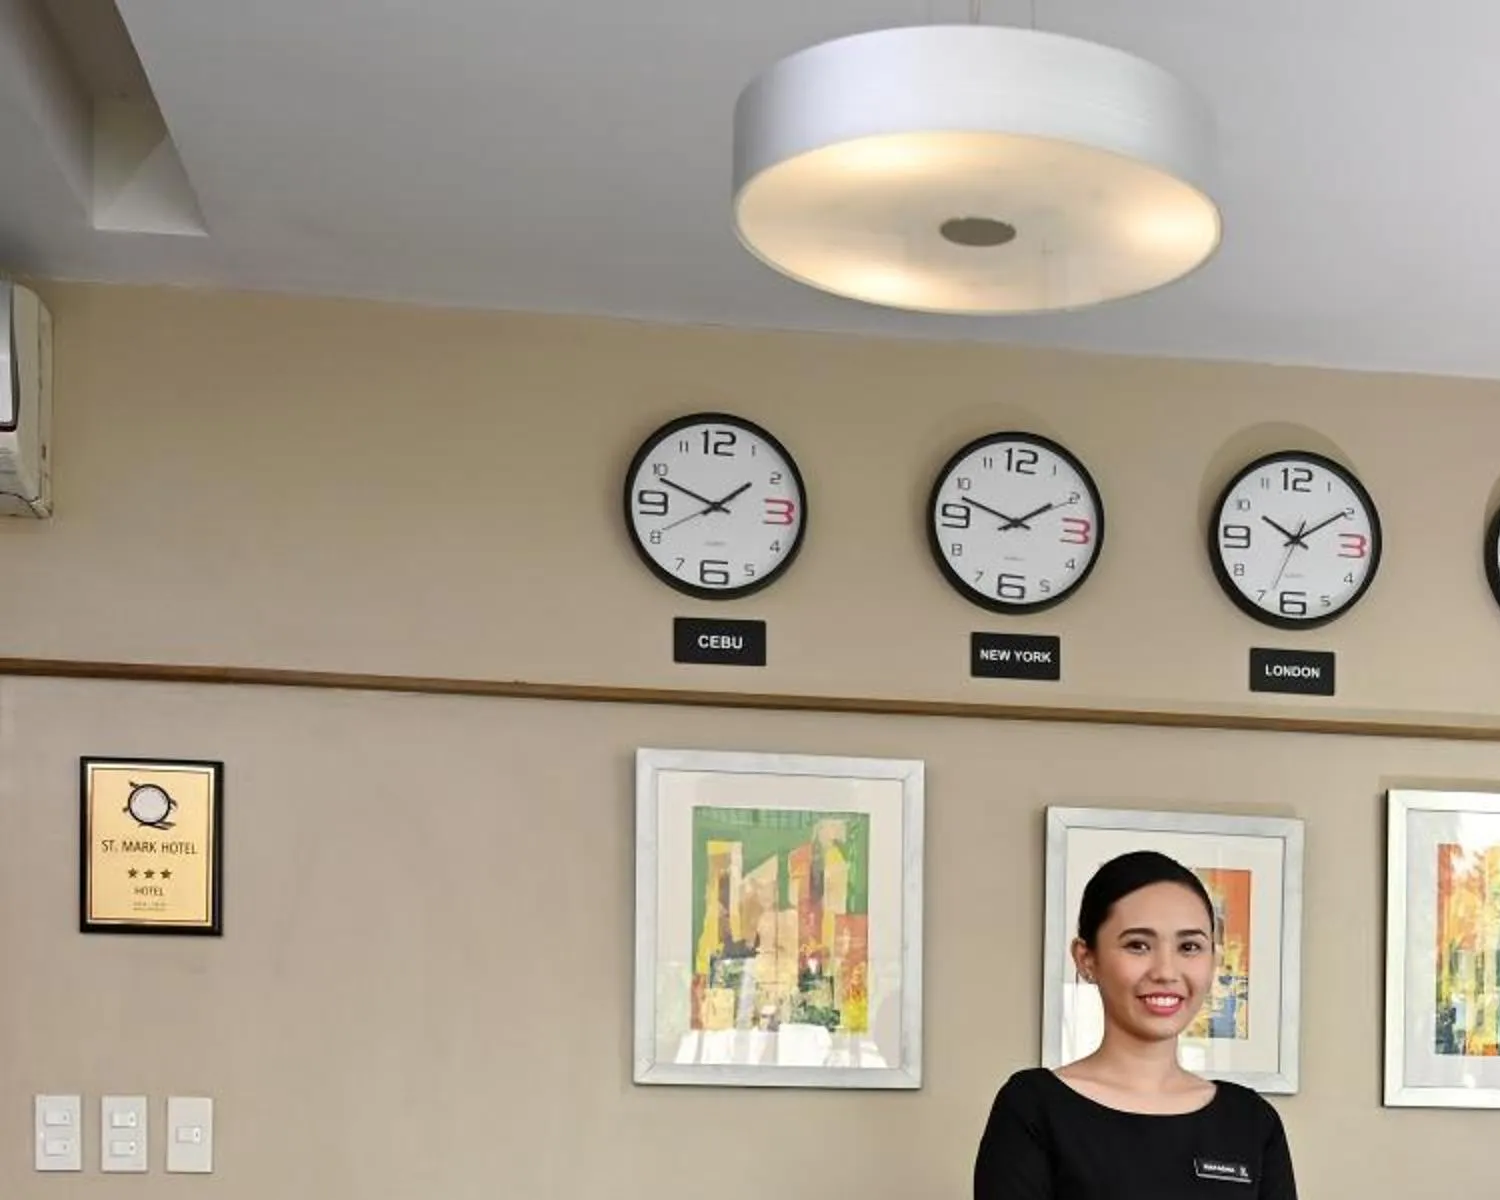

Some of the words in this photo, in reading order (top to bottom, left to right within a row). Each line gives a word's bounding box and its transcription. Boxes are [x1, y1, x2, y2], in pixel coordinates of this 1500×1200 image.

[679, 440, 689, 453] 11
[701, 429, 737, 457] 12
[983, 456, 993, 469] 11
[1004, 447, 1039, 475] 12
[652, 463, 669, 476] 10
[769, 471, 782, 485] 2
[957, 477, 971, 491] 10
[1261, 477, 1270, 490] 11
[1282, 467, 1313, 492] 12
[638, 490, 669, 516] 9
[1069, 491, 1081, 505] 2
[763, 498, 795, 526] 3
[941, 503, 971, 529] 9
[1344, 507, 1355, 521] 2
[650, 529, 662, 545] 8
[1059, 517, 1091, 545] 3
[1223, 525, 1251, 549] 9
[769, 540, 781, 553] 4
[951, 543, 963, 556] 8
[1337, 533, 1367, 559] 3
[675, 557, 685, 571] 7
[744, 564, 755, 577] 5
[1065, 558, 1076, 571] 4
[1233, 563, 1245, 577] 8
[699, 559, 729, 585] 6
[974, 570, 984, 582] 7
[1343, 572, 1354, 584] 4
[997, 573, 1025, 599] 6
[1039, 579, 1050, 593] 5
[1256, 590, 1266, 602] 7
[1320, 595, 1331, 608] 5
[1280, 591, 1307, 616] 6
[697, 635, 743, 649] CEBU
[980, 649, 1011, 661] NEW
[1014, 650, 1052, 663] YORK
[1265, 664, 1320, 678] LONDON
[101, 839, 118, 852] ST.
[122, 840, 157, 854] MARK
[161, 841, 198, 855] HOTEL
[133, 886, 164, 897] HOTEL
